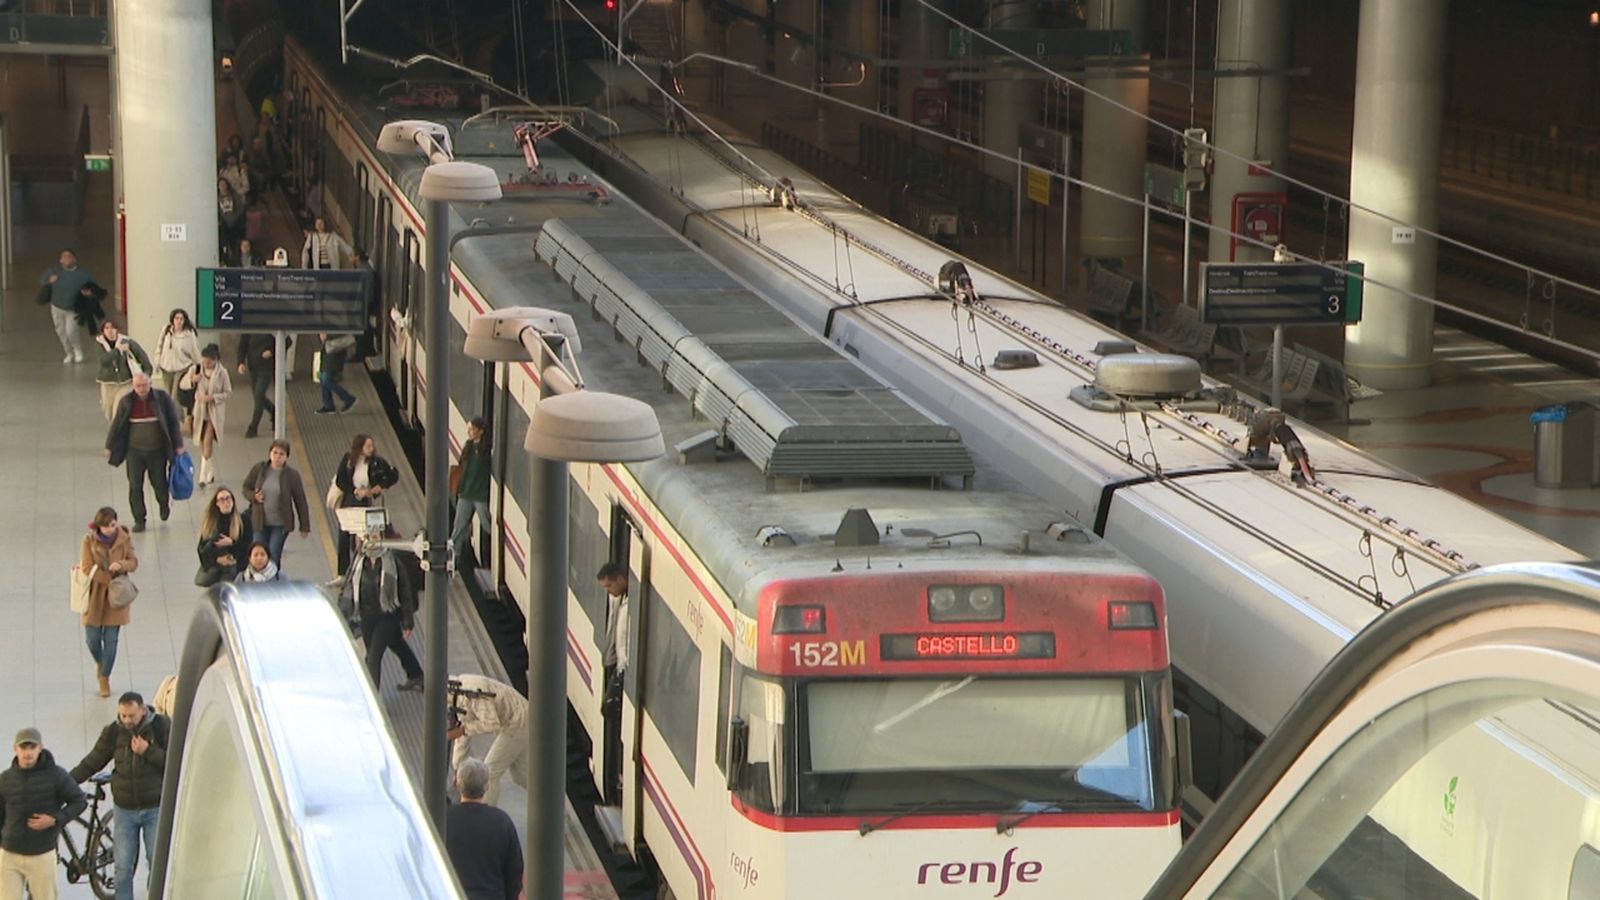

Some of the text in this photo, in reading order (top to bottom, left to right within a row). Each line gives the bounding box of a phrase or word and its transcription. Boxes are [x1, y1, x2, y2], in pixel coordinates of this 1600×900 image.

[221, 301, 234, 320] 2
[1328, 295, 1340, 314] 3
[789, 640, 865, 667] 152M
[917, 635, 1017, 655] CASTELLO
[730, 851, 759, 890] renfe
[916, 846, 1043, 898] renfe
